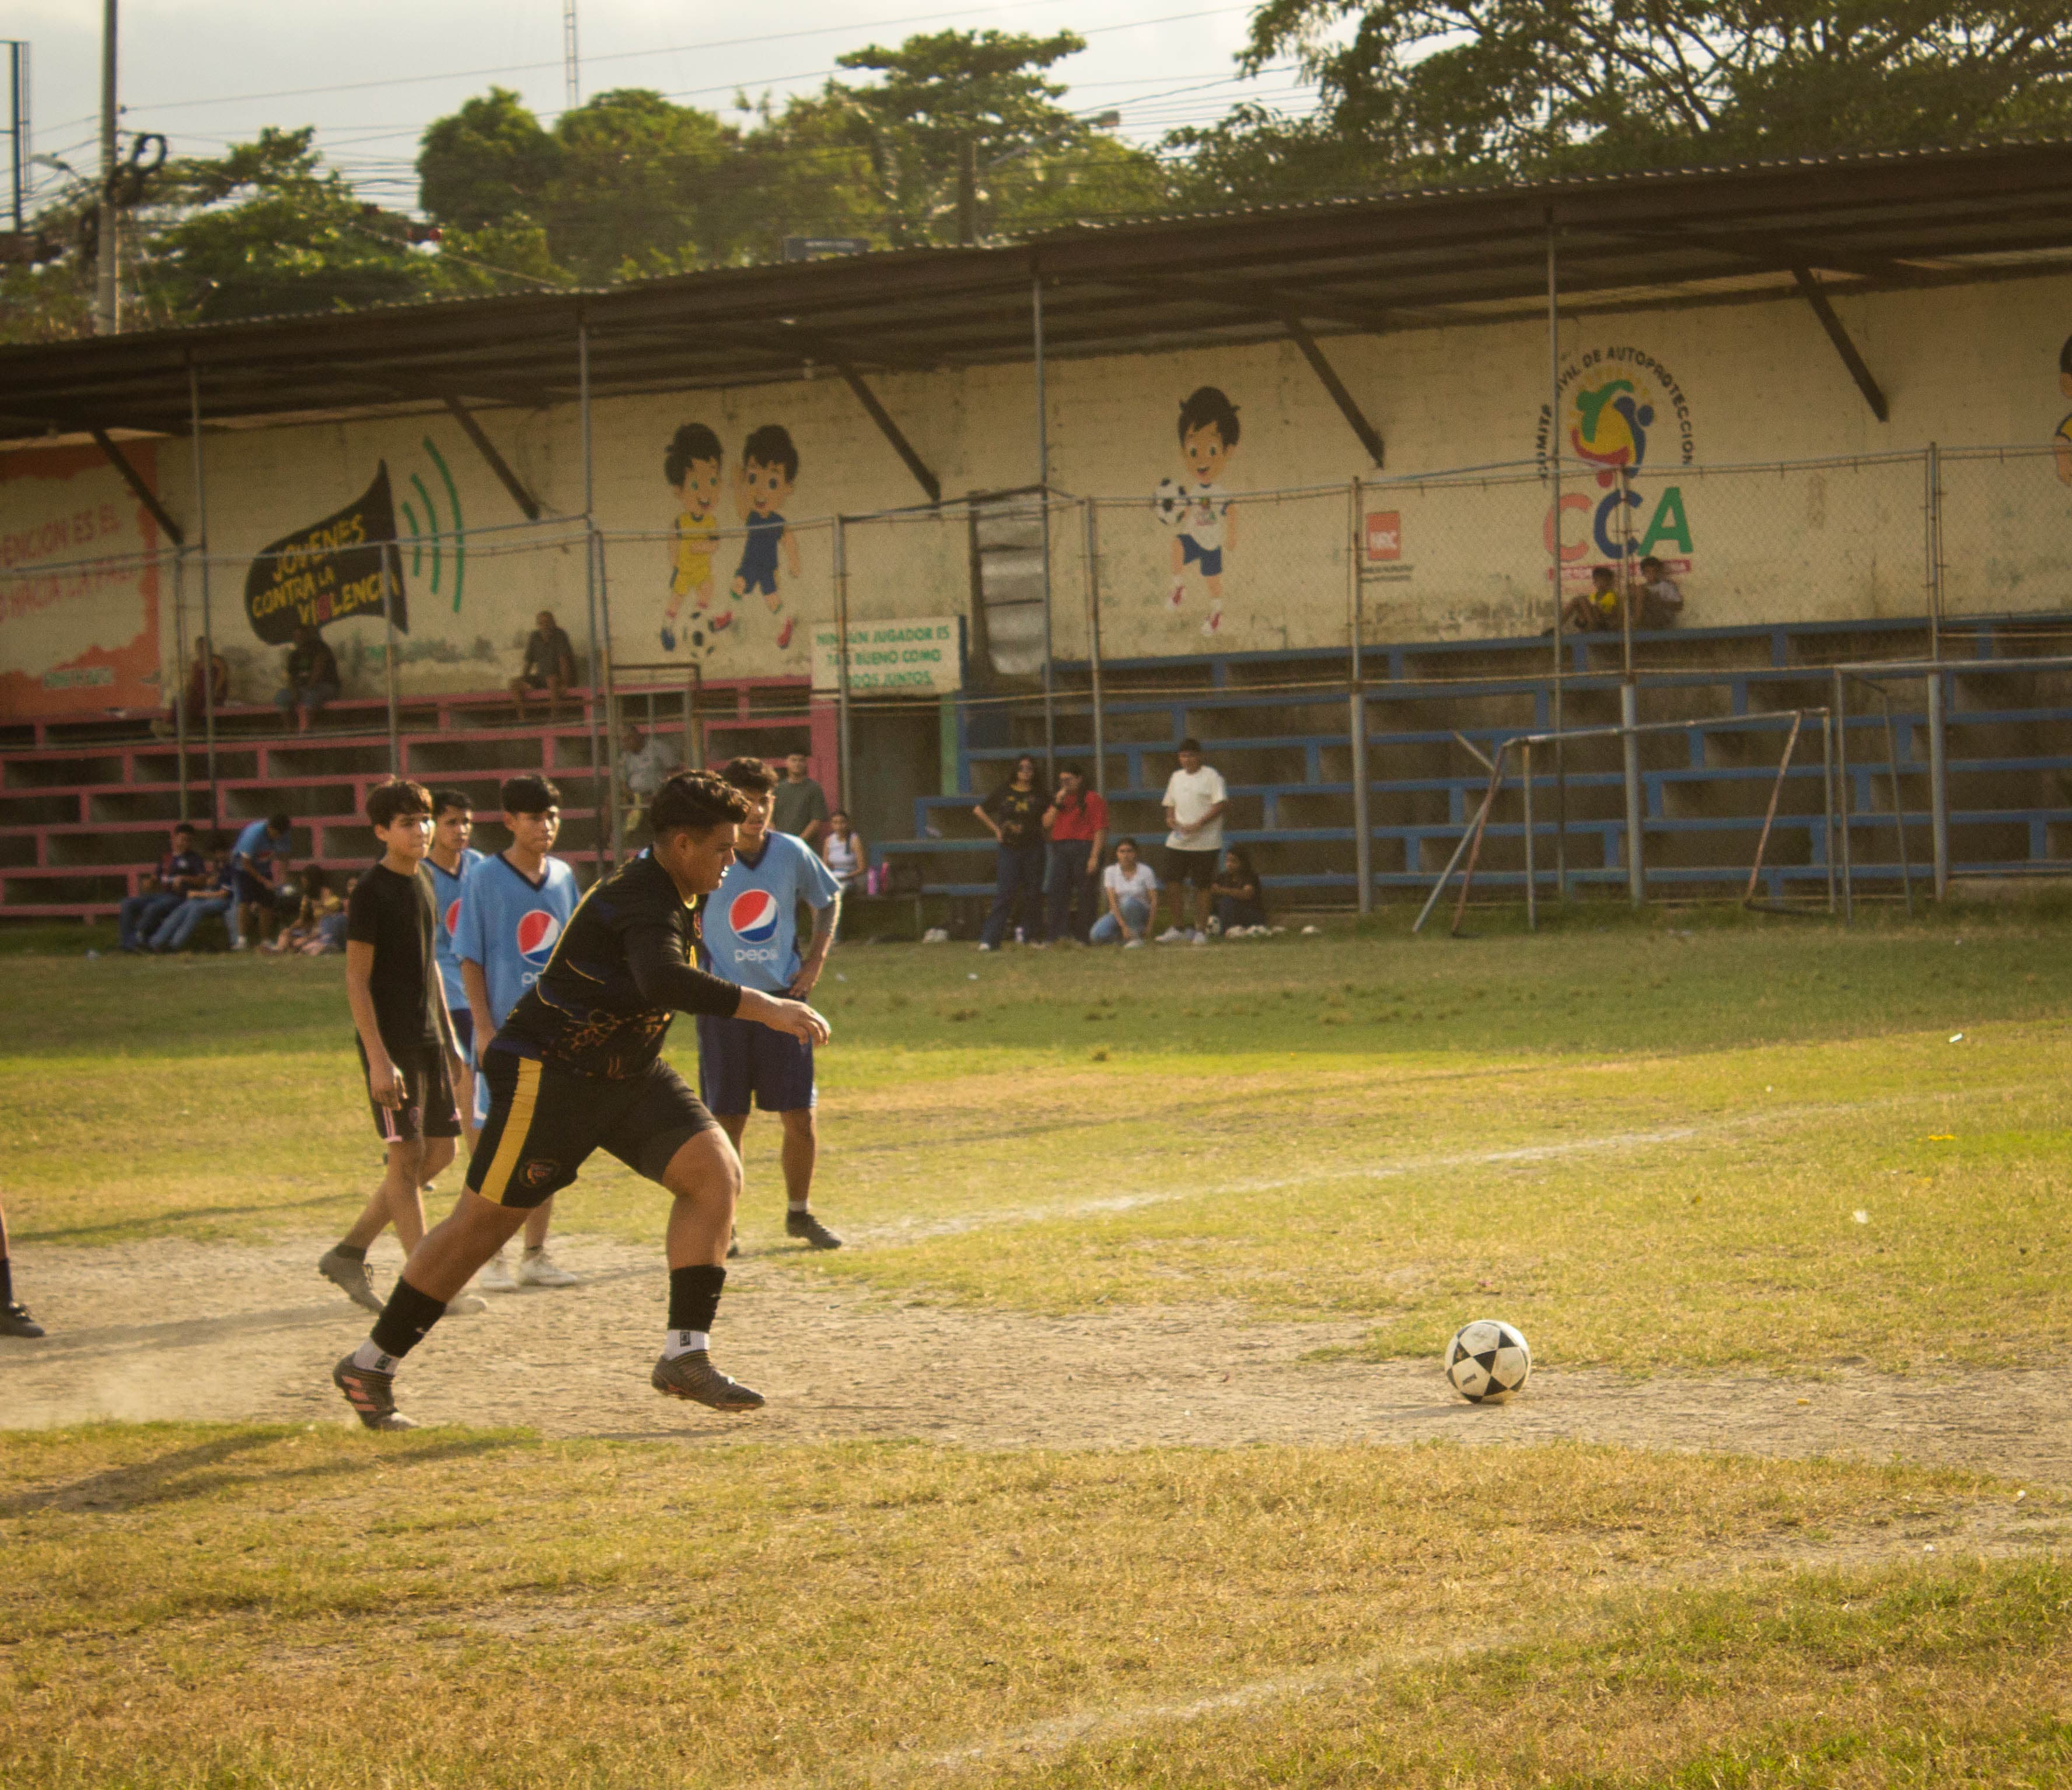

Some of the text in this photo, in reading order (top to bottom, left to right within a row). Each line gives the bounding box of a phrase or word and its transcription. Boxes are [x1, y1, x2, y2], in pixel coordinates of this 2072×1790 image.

[1582, 349, 1601, 368] DE
[1543, 487, 1693, 561] CCA
[272, 514, 366, 582] JOVENES
[252, 566, 336, 618] CONTRA LA
[817, 625, 950, 645] NINUN JUGADOR ES
[903, 648, 942, 663] COMO
[883, 670, 933, 686] JUNTOS
